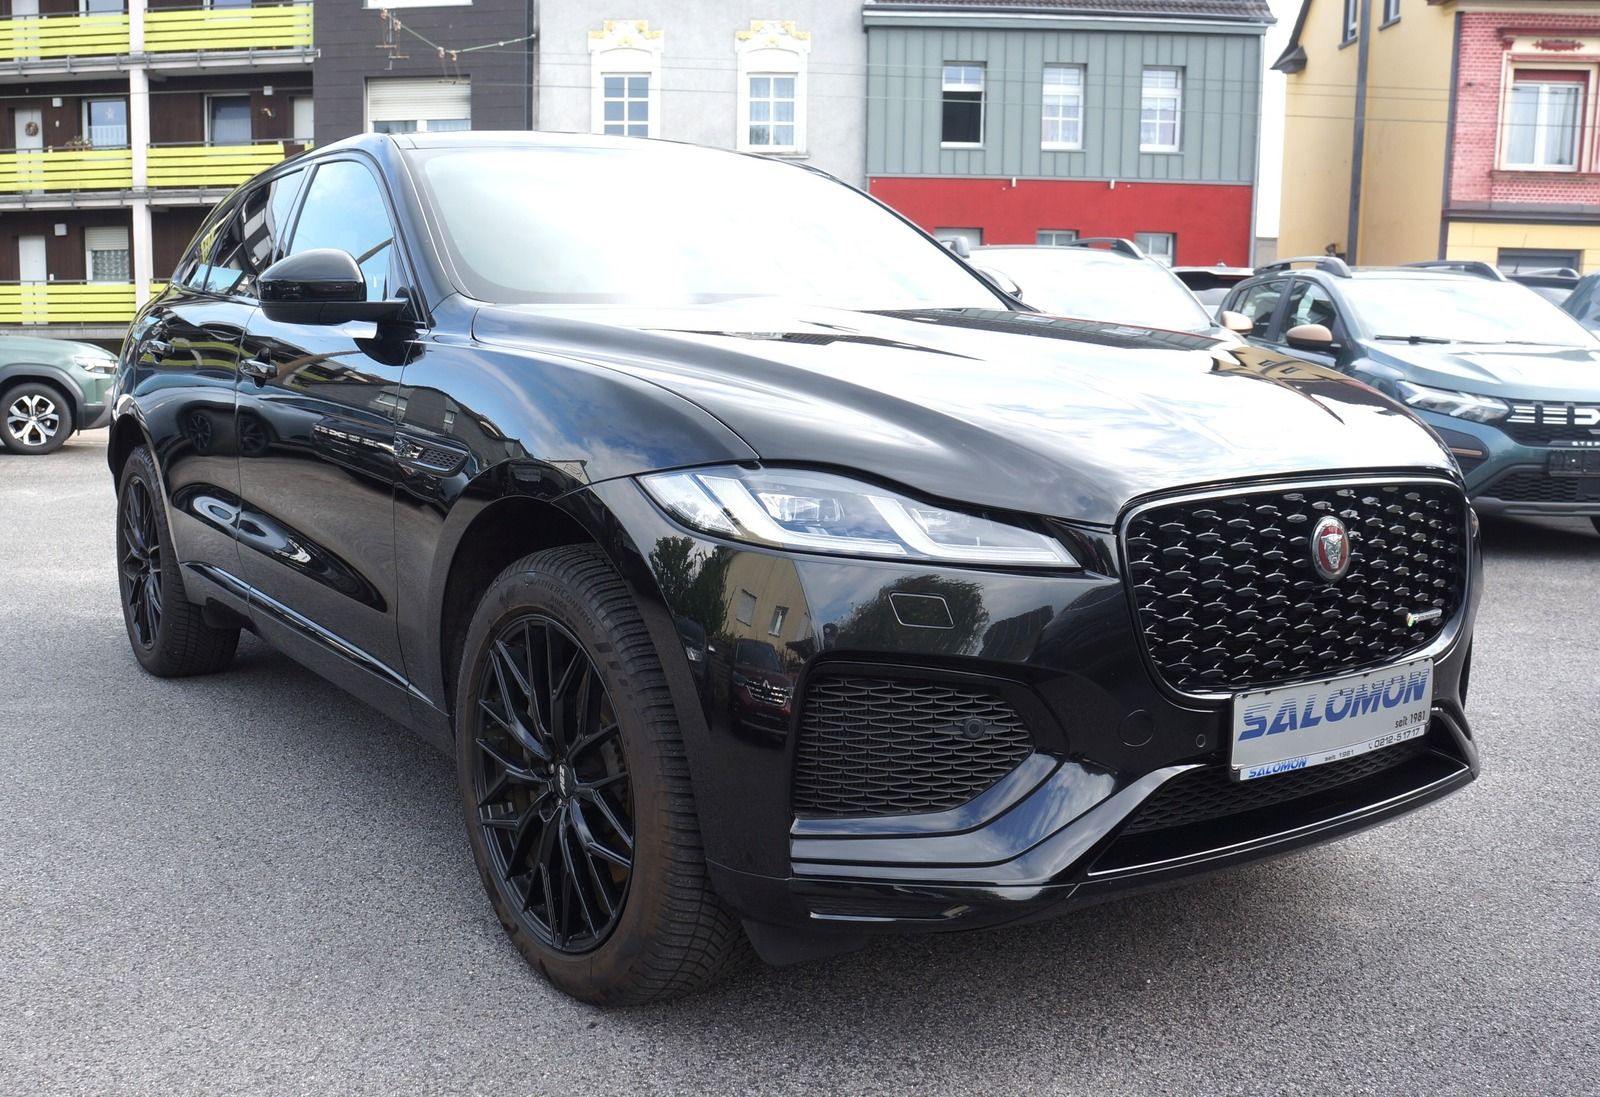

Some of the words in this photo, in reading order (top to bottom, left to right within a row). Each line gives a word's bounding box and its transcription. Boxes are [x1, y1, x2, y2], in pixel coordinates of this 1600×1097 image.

[1238, 668, 1431, 741] SALOMON
[1395, 715, 1408, 729] seit
[1410, 710, 1425, 724] 1981
[1248, 757, 1307, 778] SALOMON
